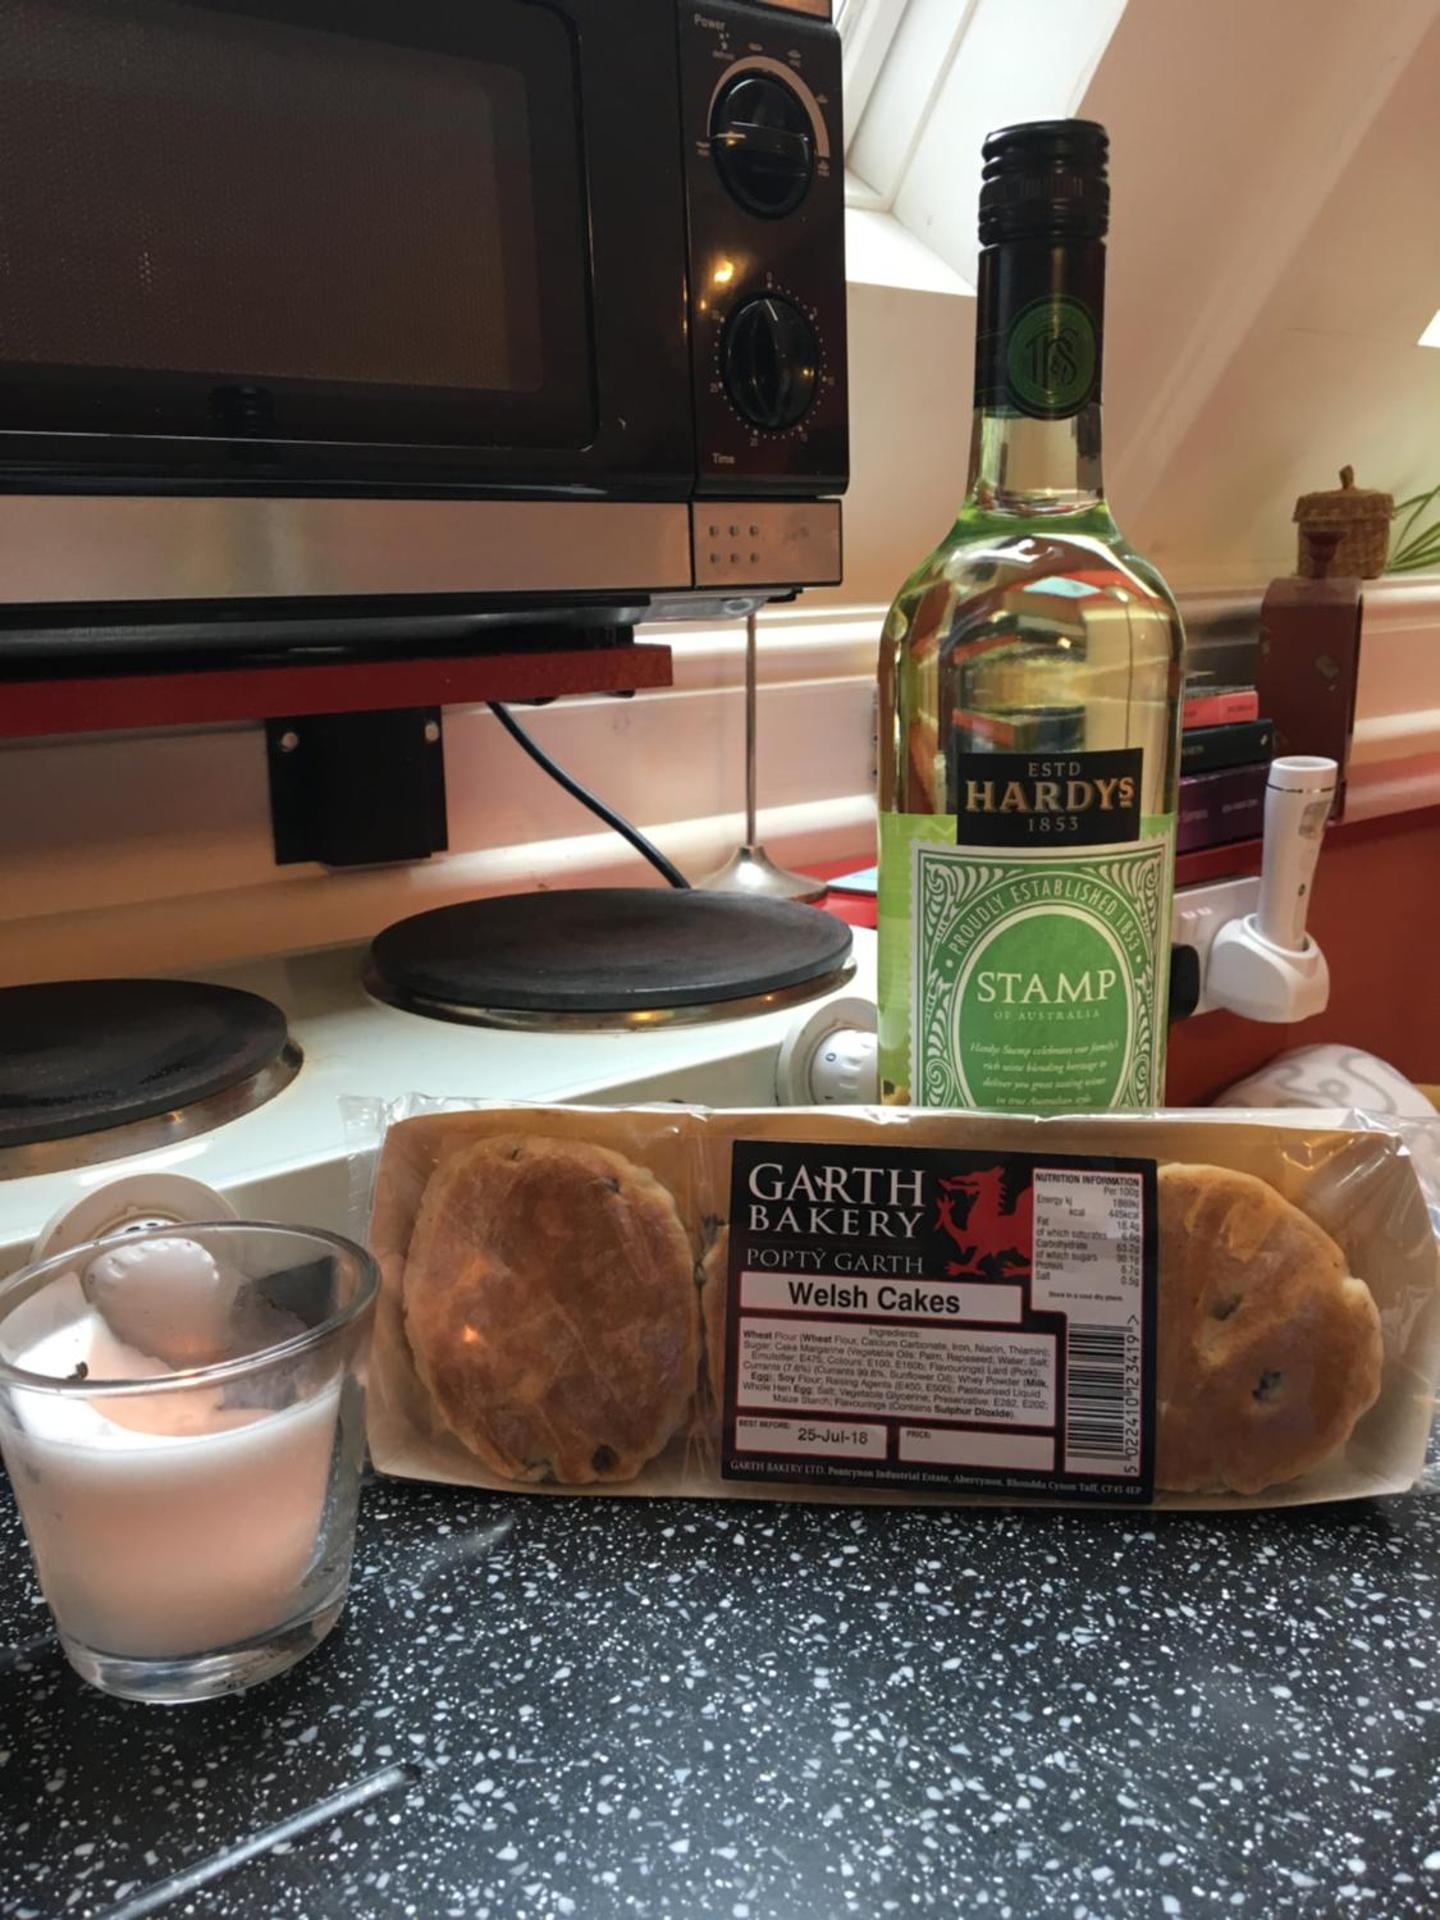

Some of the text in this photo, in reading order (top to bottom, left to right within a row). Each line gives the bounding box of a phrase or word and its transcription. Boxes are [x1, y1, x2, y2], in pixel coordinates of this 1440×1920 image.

[693, 13, 726, 30] Power
[712, 452, 735, 465] Time
[1027, 761, 1082, 778] ESTD
[1027, 816, 1080, 832] 1853
[949, 878, 1142, 955] PROUDLY ESTABLISHED 1853
[976, 970, 1117, 1004] STAMP
[993, 1009, 1100, 1020] OF AUSTRALIA
[1026, 1061, 1064, 1074] blending
[1066, 1061, 1098, 1072] heritage
[982, 1077, 1012, 1087] deliver
[1013, 1082, 1030, 1091] you
[1030, 1081, 1054, 1092] great
[1027, 1095, 1073, 1105] Australian
[748, 1161, 926, 1208] GARTH
[1036, 1172, 1140, 1186] NUTRITION INFORMATION
[1104, 1186, 1140, 1198] Per 100g
[1036, 1194, 1063, 1206] Energy
[1069, 1208, 1085, 1216] kcal
[749, 1203, 926, 1239] BAKERY
[1036, 1216, 1050, 1225] Fat
[1036, 1227, 1045, 1236] of
[1046, 1229, 1069, 1237] which
[1036, 1238, 1088, 1250] Carbohydrate
[1036, 1250, 1045, 1258] of
[1046, 1251, 1069, 1260] which
[1071, 1253, 1098, 1262] sugars
[834, 1252, 924, 1275] GARTH
[1036, 1260, 1064, 1271] Protein
[1036, 1271, 1050, 1281] Salt
[788, 1281, 961, 1314] Welsh Cakes
[868, 1327, 920, 1340] Ingredients:
[743, 1329, 771, 1339] Wheat
[774, 1331, 797, 1341] Flour
[800, 1333, 832, 1343] (Wheat
[860, 1336, 898, 1346] Calcium
[974, 1343, 1006, 1353] Niacin,
[774, 1341, 797, 1352] Cake
[799, 1343, 844, 1355] Margarine
[847, 1345, 893, 1358] (Vegetable
[743, 1360, 781, 1372] Currants
[814, 1364, 854, 1376] (Currants
[889, 1369, 934, 1381] Sunflower
[958, 1372, 982, 1383] Whey
[985, 1374, 1019, 1385] Powder
[987, 1364, 1007, 1374] Lard
[742, 1381, 770, 1393] Whole
[772, 1383, 791, 1394] Hen
[839, 1387, 883, 1400] Vegetable
[777, 1372, 795, 1384] Soy
[825, 1375, 858, 1387] Raising
[860, 1377, 892, 1389] Agents
[958, 1383, 1010, 1396] Pasteurised
[1013, 1386, 1041, 1398] Liquid
[772, 1394, 798, 1404] Maize
[834, 1397, 886, 1409] Flavourings
[888, 1400, 931, 1412] (Contains
[934, 1403, 971, 1414] Sulphur
[738, 1419, 759, 1429] BEST
[797, 1427, 869, 1446] 25-Jul-18
[906, 1429, 931, 1440] PRICE:
[730, 1460, 765, 1472] GARTH
[766, 1462, 802, 1474] BAKERY
[876, 1468, 921, 1481] Industrial
[922, 1472, 951, 1484] Estate,
[1006, 1478, 1048, 1490] Rhondda
[1048, 1480, 1076, 1492] Cynon
[1124, 1465, 1138, 1474] 5
